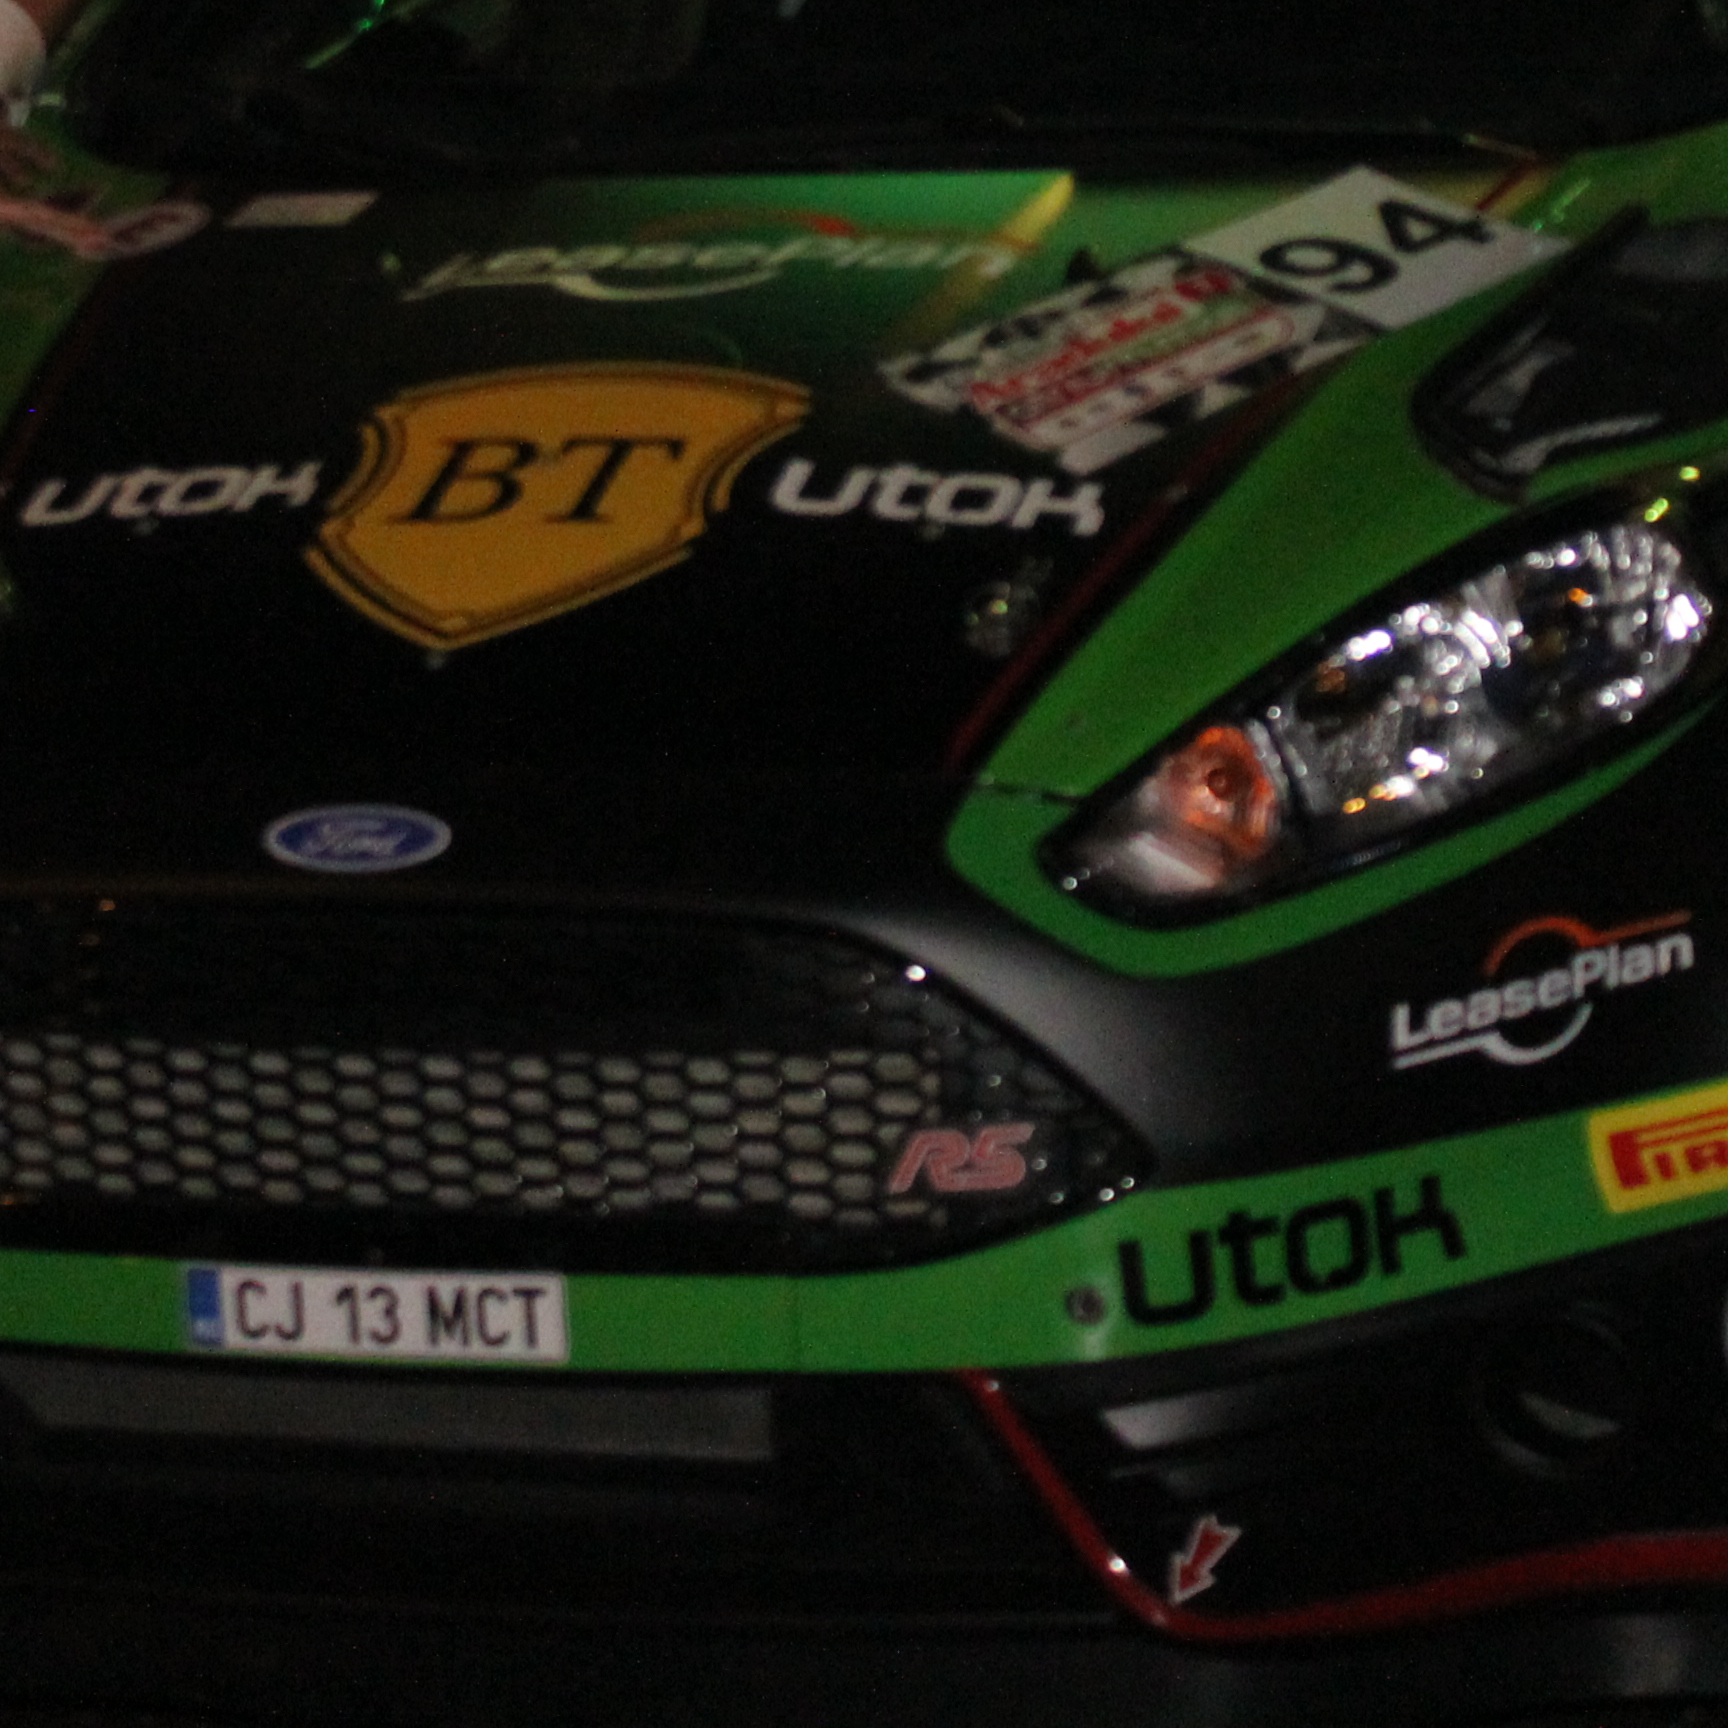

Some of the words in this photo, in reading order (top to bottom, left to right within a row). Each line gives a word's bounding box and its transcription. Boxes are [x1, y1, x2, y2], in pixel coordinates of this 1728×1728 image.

[1259, 197, 1496, 296] 94
[385, 436, 684, 526] BT
[1390, 932, 1696, 1051] LeasePlan
[886, 1122, 1036, 1194] RS
[235, 1279, 304, 1342] CJ
[335, 1284, 400, 1346] 13
[427, 1285, 547, 1349] MCT
